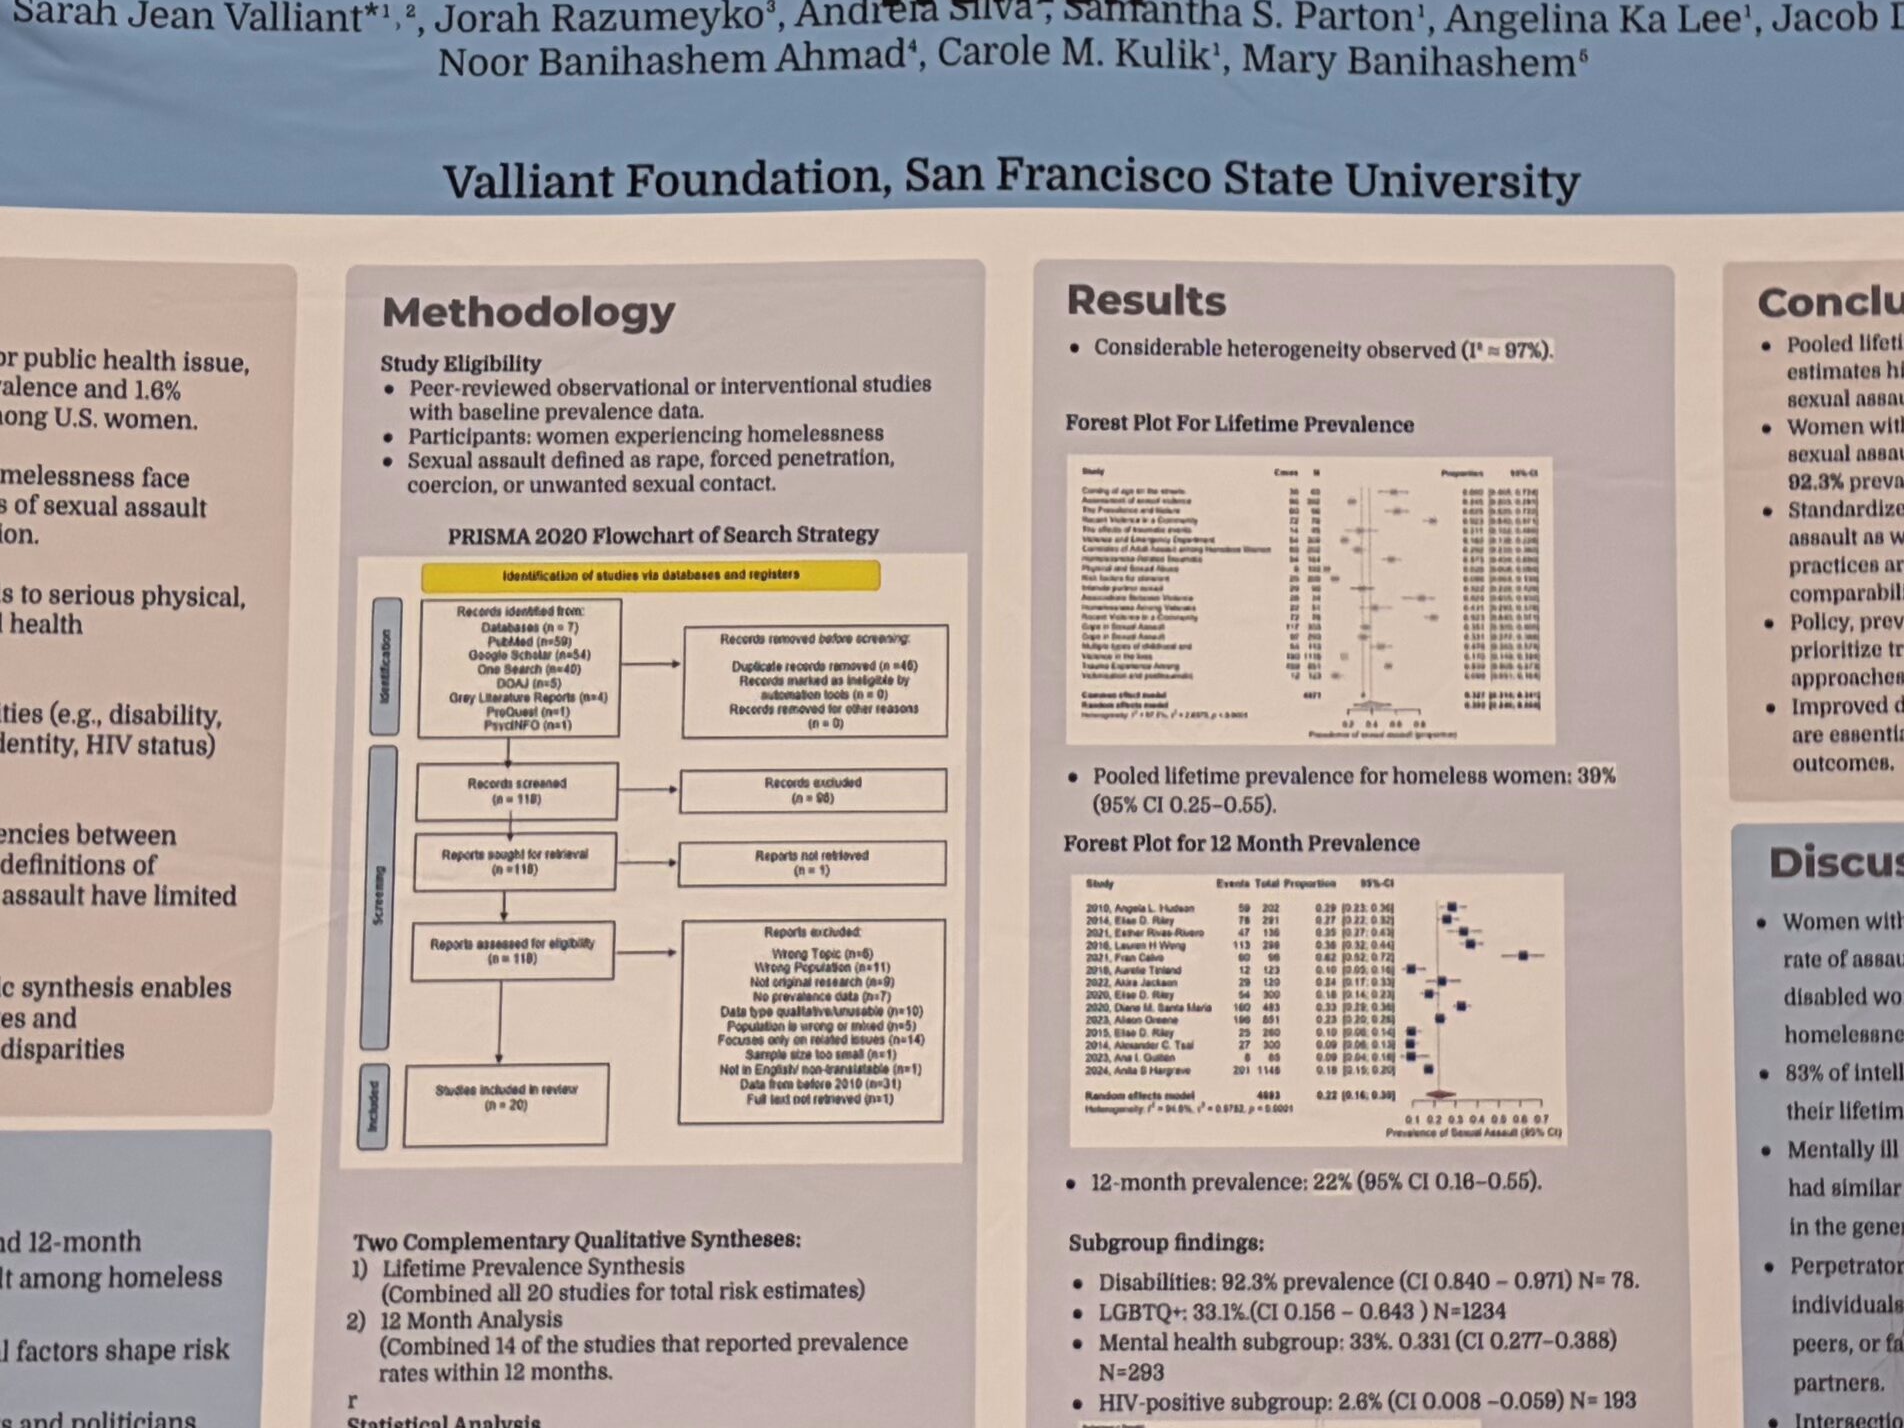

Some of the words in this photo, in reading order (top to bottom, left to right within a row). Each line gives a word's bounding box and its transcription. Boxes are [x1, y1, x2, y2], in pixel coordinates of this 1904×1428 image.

[127, 0, 215, 31] Jean
[434, 1, 541, 34] Jorah
[1443, 1, 1610, 41] Angelina
[1619, 3, 1668, 34] Ka
[1771, 0, 1879, 34] Jacob
[438, 47, 530, 78] Noor
[538, 42, 767, 78] Banihashem
[938, 32, 1051, 67] Carole
[1061, 35, 1104, 67] M.
[1242, 41, 1338, 82] Mary
[442, 161, 616, 201] Valliant
[626, 157, 892, 200] Foundation,
[905, 156, 986, 193] San
[996, 155, 1212, 195] Francisco
[1224, 158, 1333, 198] State
[1345, 161, 1582, 208] University
[1068, 282, 1227, 318] Results
[383, 293, 677, 336] Methodology
[1094, 336, 1223, 358] Considerable
[1227, 337, 1362, 363] heterogeneity
[1366, 340, 1457, 360] observed
[1787, 332, 1854, 354] Pooled
[23, 346, 97, 373] public
[102, 346, 177, 373] health
[182, 350, 250, 377] issue,
[380, 353, 440, 377] Study
[443, 353, 543, 377] Eligibility
[409, 377, 552, 399] Peer-reviewed
[556, 376, 690, 398] observational
[694, 380, 717, 397] or
[720, 373, 858, 396] interventional
[862, 373, 932, 394] studies
[1065, 413, 1129, 432] Forest
[1133, 411, 1172, 432] Plot
[1176, 413, 1212, 434] For
[1214, 412, 1299, 434] Lifetime
[1304, 414, 1415, 435] Prevalence
[448, 526, 532, 546] PRISMA
[534, 526, 588, 546] 2020
[592, 525, 695, 546] Flowchart
[698, 524, 722, 545] of
[723, 522, 793, 545] Search
[796, 524, 880, 547] Strategy
[1782, 912, 1860, 933] Women
[1785, 1063, 1824, 1084] 83%
[1828, 1061, 1851, 1083] of
[28, 1228, 142, 1255] 12-month
[352, 1232, 399, 1253] Two
[402, 1230, 571, 1256] Complementary
[574, 1228, 687, 1255] Qualitative
[690, 1227, 801, 1253] Syntheses:
[1068, 1231, 1170, 1256] Subgroup
[1174, 1230, 1265, 1256] findings:
[1099, 1271, 1217, 1293] Disabilities:
[1221, 1272, 1278, 1293] 92.3%
[1282, 1270, 1395, 1296] prevalence
[1399, 1268, 1429, 1294] (CI
[1433, 1271, 1491, 1292] 0.840
[1514, 1267, 1573, 1293] 0.971)
[1611, 1269, 1640, 1290] 78.
